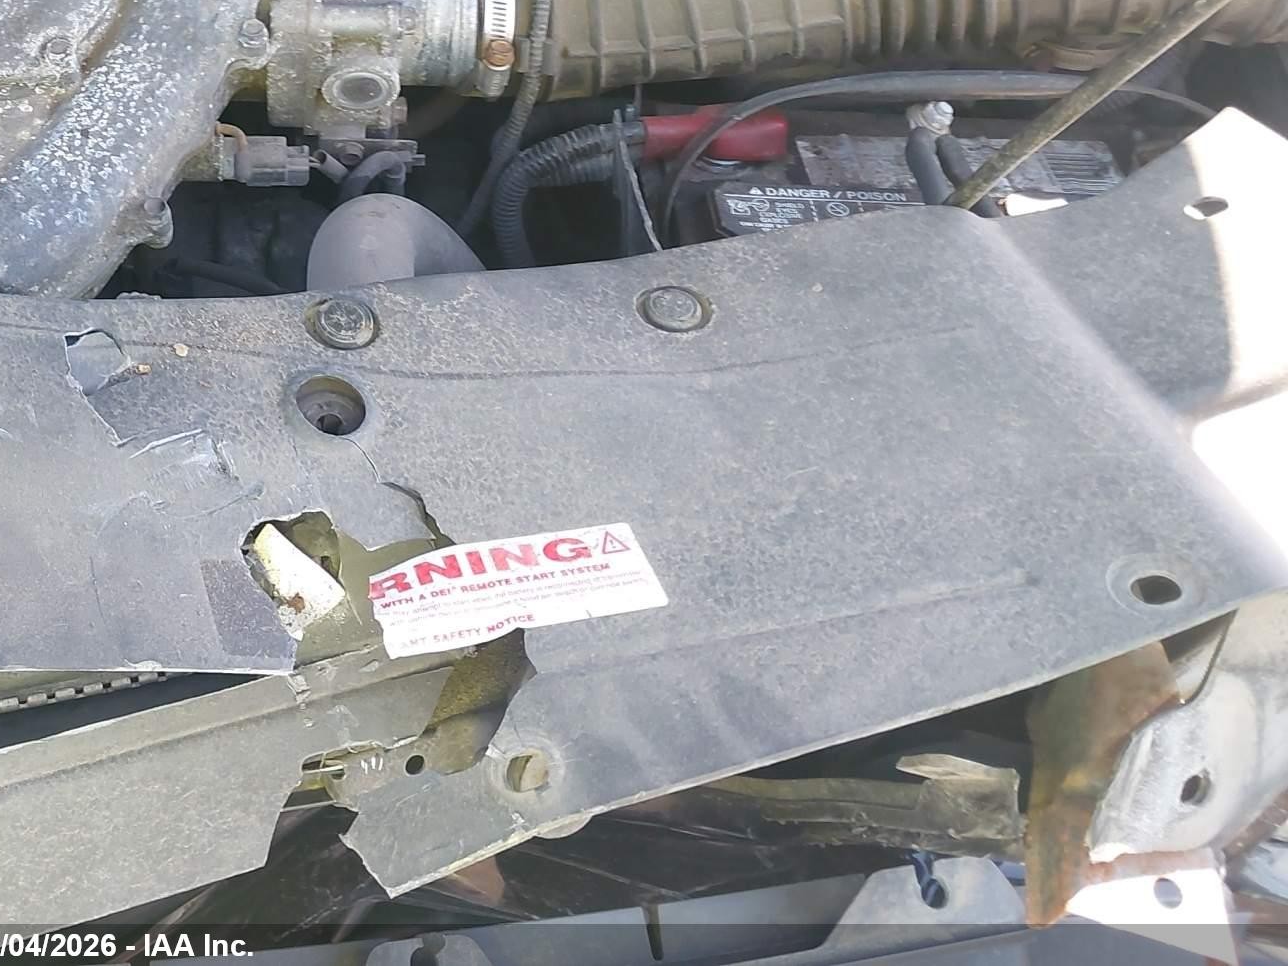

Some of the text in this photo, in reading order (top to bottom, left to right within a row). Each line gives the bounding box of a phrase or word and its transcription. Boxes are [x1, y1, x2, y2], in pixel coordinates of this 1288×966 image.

[765, 187, 830, 199] DANGER
[846, 191, 907, 202] POISON
[380, 594, 414, 610] WITH
[418, 593, 427, 602] A
[460, 577, 513, 594] REMOTE
[516, 570, 556, 585] START
[560, 562, 611, 577] SYSTEM
[433, 627, 482, 644] SAFETY
[486, 613, 537, 634] NOTICE
